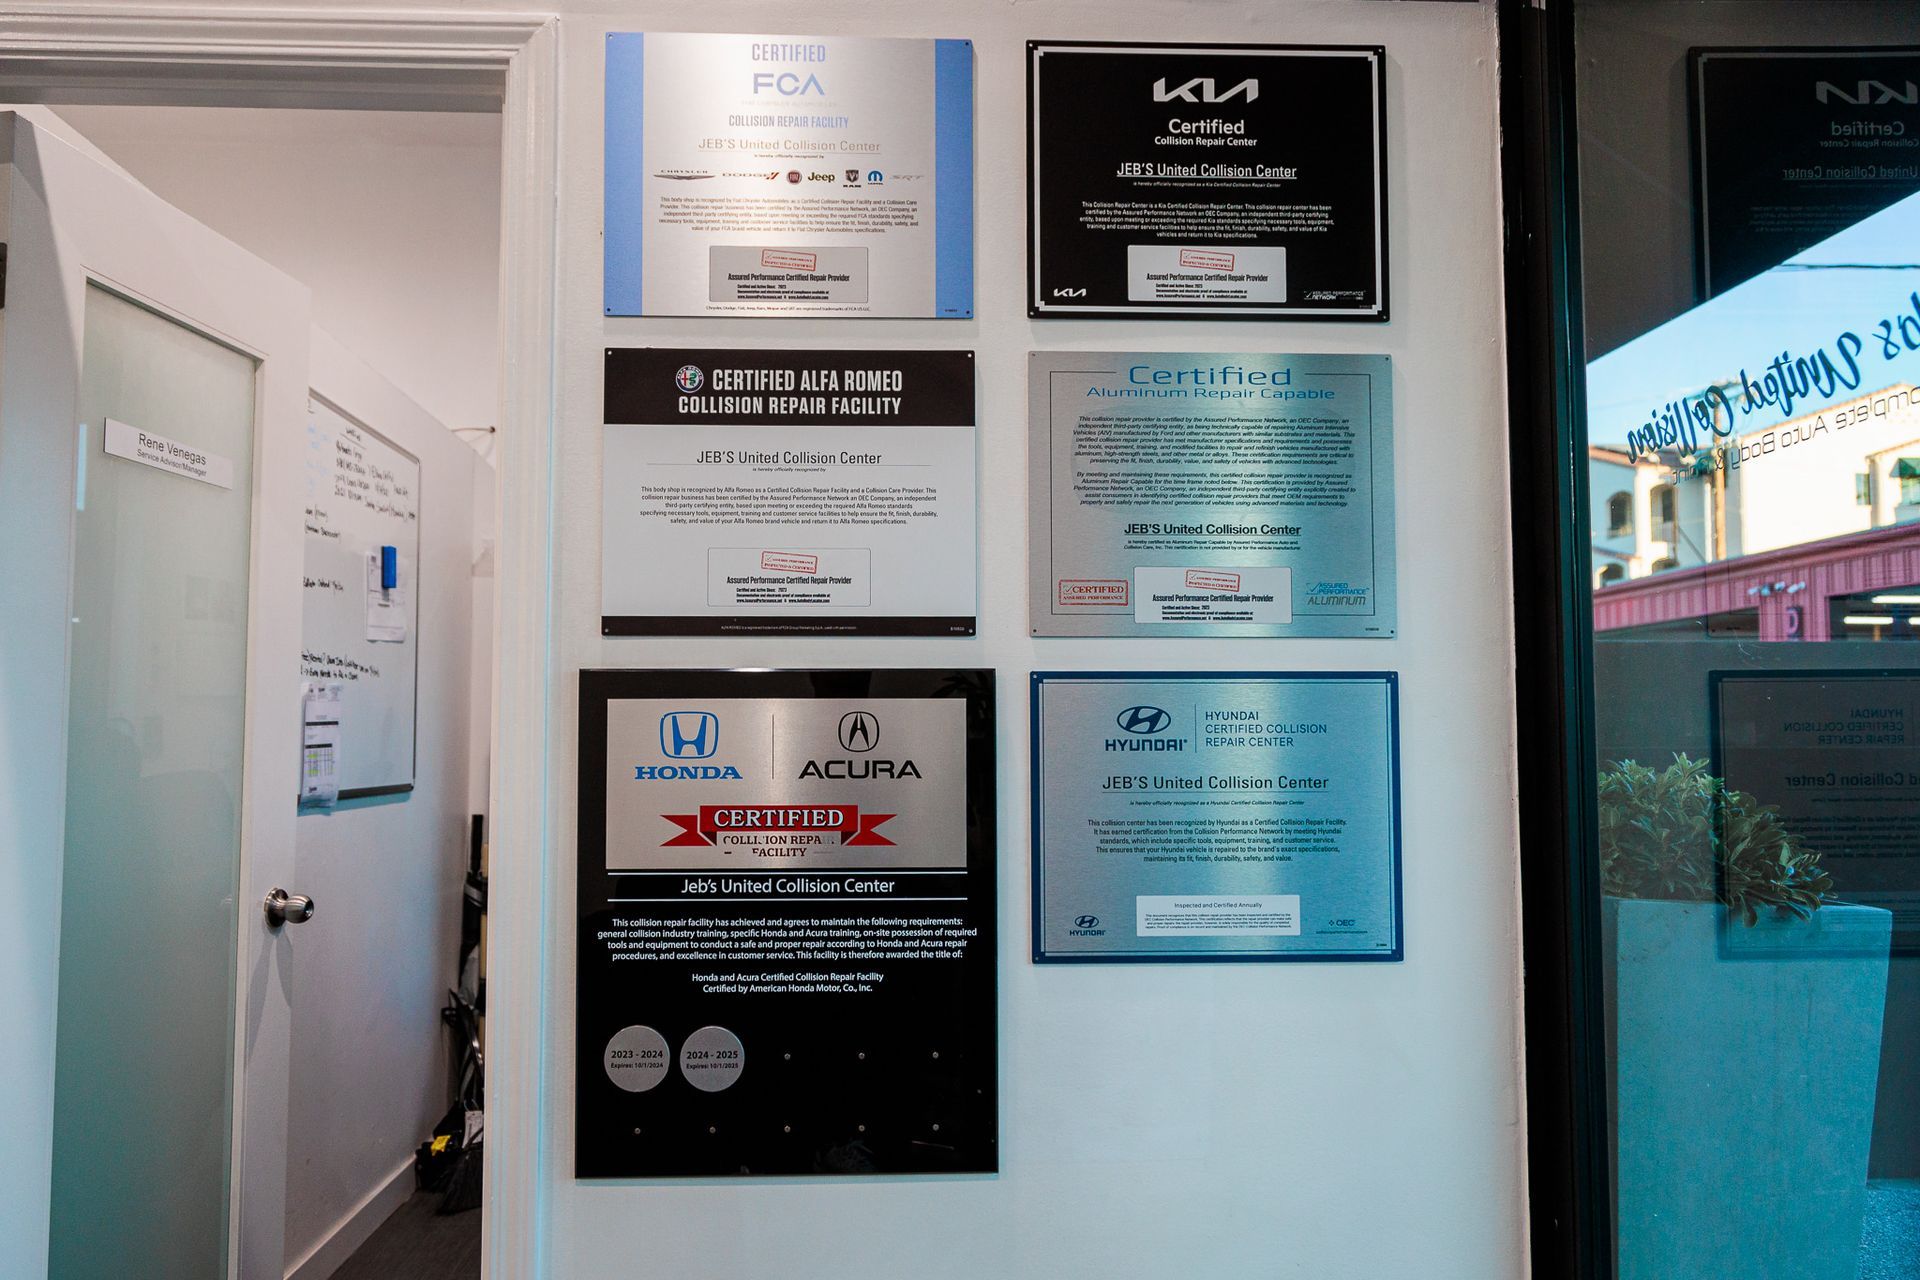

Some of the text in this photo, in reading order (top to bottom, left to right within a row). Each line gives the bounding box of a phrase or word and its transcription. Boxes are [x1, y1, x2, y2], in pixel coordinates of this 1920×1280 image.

[752, 44, 826, 62] CERTIFIED
[753, 73, 825, 96] FCA
[729, 115, 849, 128] COLLISION REPAIR FACILITY
[1168, 119, 1244, 134] Certified
[698, 138, 880, 151] JEB'S United Collision Center
[1154, 136, 1258, 147] Collision Repair Center
[1117, 163, 1297, 177] JEB'S United Collision Center
[808, 172, 835, 183] Jeep
[809, 274, 827, 282] Repair
[1228, 274, 1245, 282] Repair
[713, 370, 902, 391] CERTIFIED ALFA ROMEO
[1130, 365, 1292, 386] Certified
[1086, 388, 1335, 400] Aluminum Repair Capable
[679, 396, 901, 414] COLLISION REPAIR FACILITY
[139, 433, 206, 466] Rene Venegas
[136, 448, 207, 477] Service Advisor/Manager
[697, 451, 882, 464] JEB'S United Collision Center
[1124, 524, 1302, 536] JEB'S United Collision Center
[786, 576, 810, 584] Certified
[810, 576, 828, 585] Repair
[1233, 594, 1251, 603] Repair
[1205, 711, 1259, 720] HYUNDAI
[1205, 724, 1327, 734] CERTIFIED COLLISION
[1105, 739, 1183, 751] HYUNDAI
[1205, 737, 1294, 747] REPAIR CENTER
[635, 766, 743, 779] HONDA
[799, 760, 922, 779] ACURA
[1102, 776, 1329, 789] JEB'S United Collision Center
[714, 810, 843, 826] CERTIFIED
[682, 879, 895, 893] Jeb's United Collision Center
[612, 918, 629, 927] This
[629, 918, 662, 927] collision
[663, 919, 687, 928] repair
[688, 918, 714, 928] facility
[715, 918, 729, 926] has
[730, 918, 766, 926] achieved
[766, 918, 782, 926] and
[783, 919, 810, 928] agrees
[820, 918, 856, 926] maintain
[856, 917, 870, 926] the
[871, 917, 908, 927] following
[909, 918, 963, 926] requirements:
[692, 972, 884, 982] Honda and Acura Certified Collision Repair Facility
[702, 984, 737, 993] Certified
[738, 984, 748, 994] by
[788, 984, 815, 992] Honda
[816, 984, 842, 992] Motor,
[858, 984, 873, 992] Inc.
[611, 1050, 634, 1058] 2023
[640, 1050, 663, 1058] 2024
[686, 1051, 709, 1059] 2024
[716, 1050, 738, 1059] 2025
